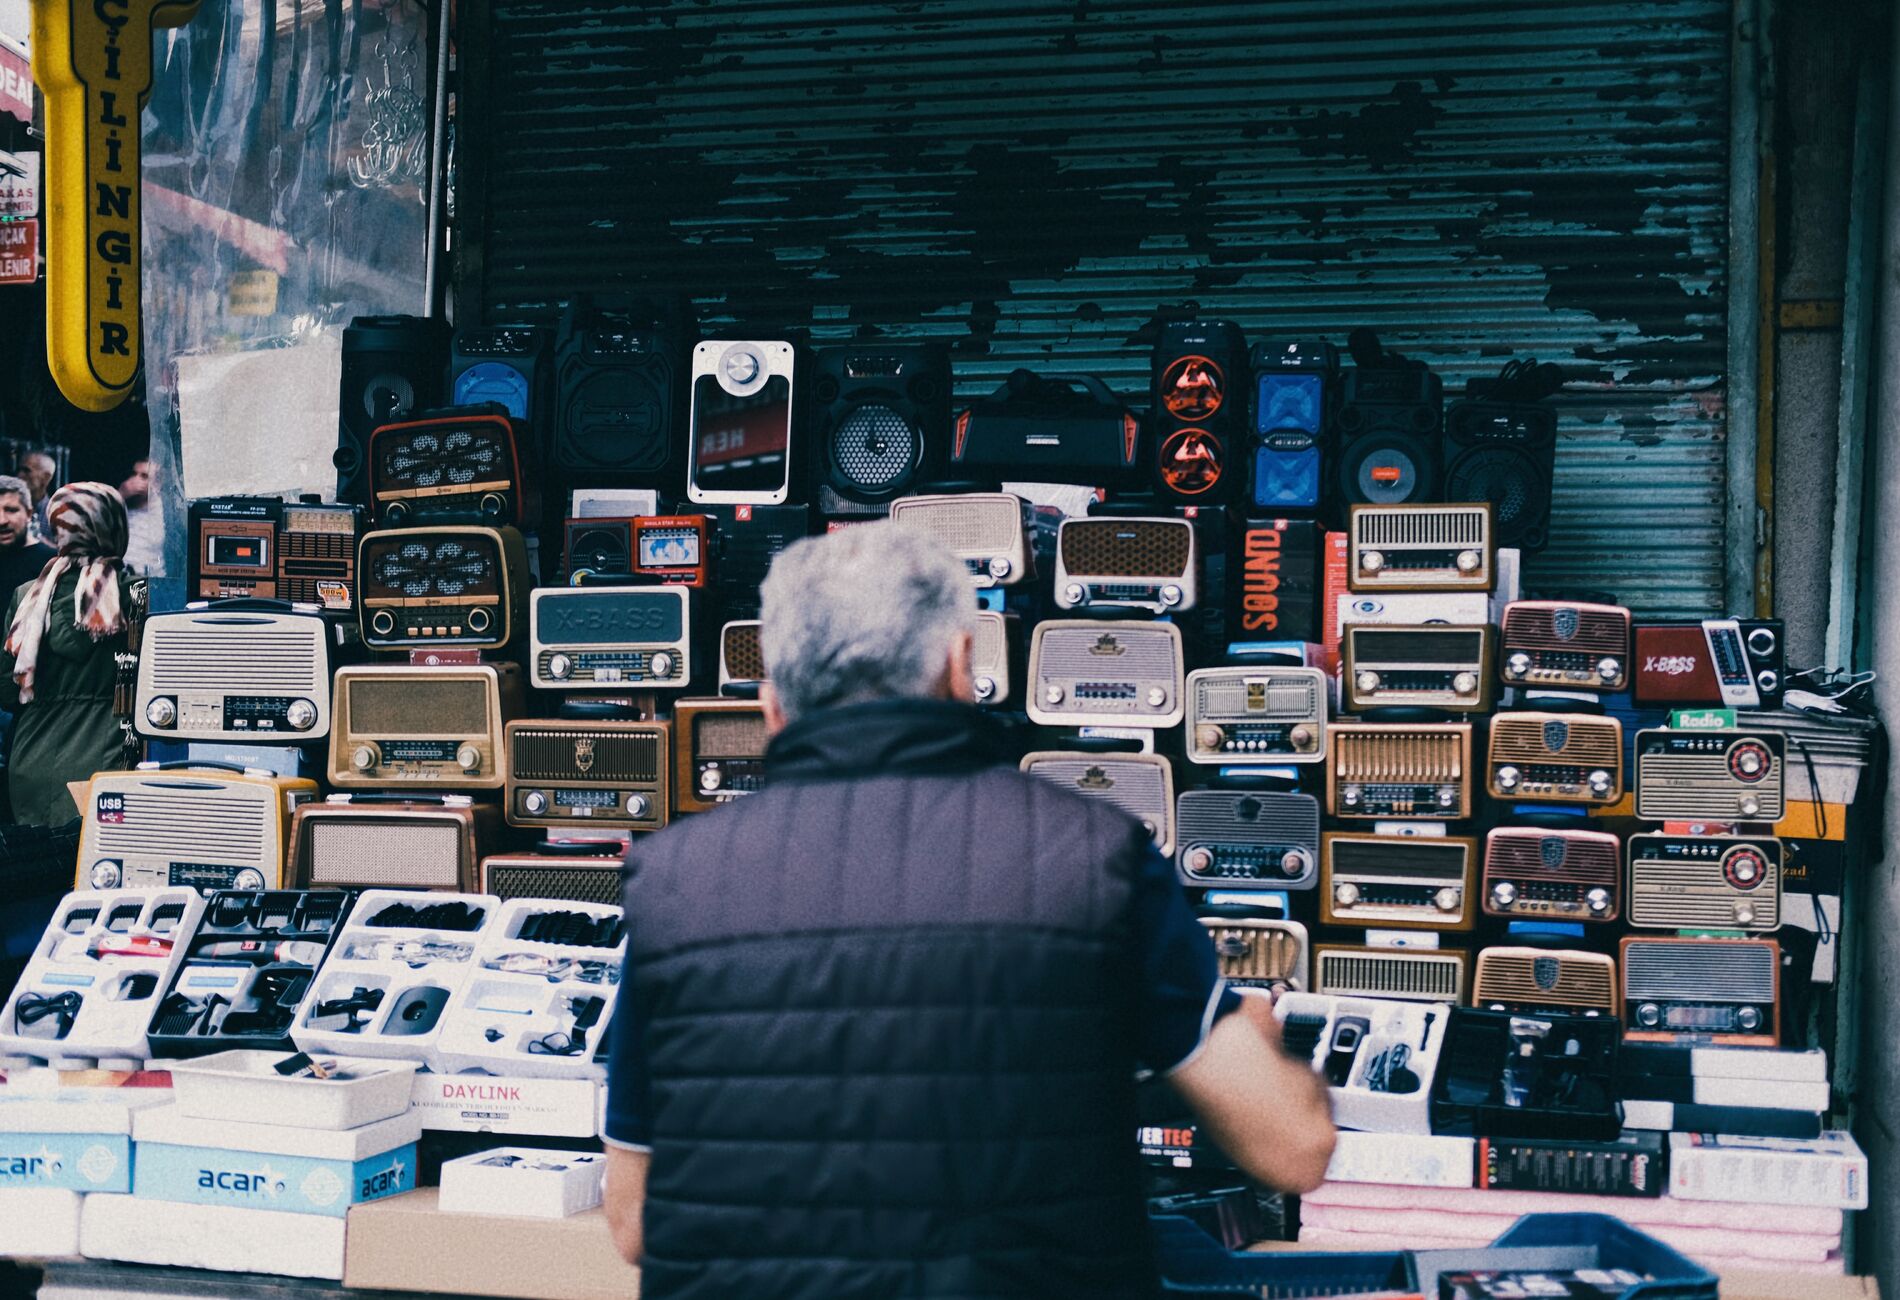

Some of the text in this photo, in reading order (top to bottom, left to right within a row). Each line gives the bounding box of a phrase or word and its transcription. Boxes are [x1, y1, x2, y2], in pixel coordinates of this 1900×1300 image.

[93, 0, 132, 356] ÇİLİNGİR
[1243, 530, 1280, 631] SOUND
[557, 607, 664, 629] X-BASS
[1643, 656, 1696, 673] X-BASS
[1680, 713, 1724, 728] Radio
[100, 798, 122, 810] USB
[443, 1084, 521, 1101] DAYLINK
[1137, 1127, 1193, 1147] ERTEC
[198, 1169, 265, 1192] acar
[361, 1168, 394, 1197] acar
